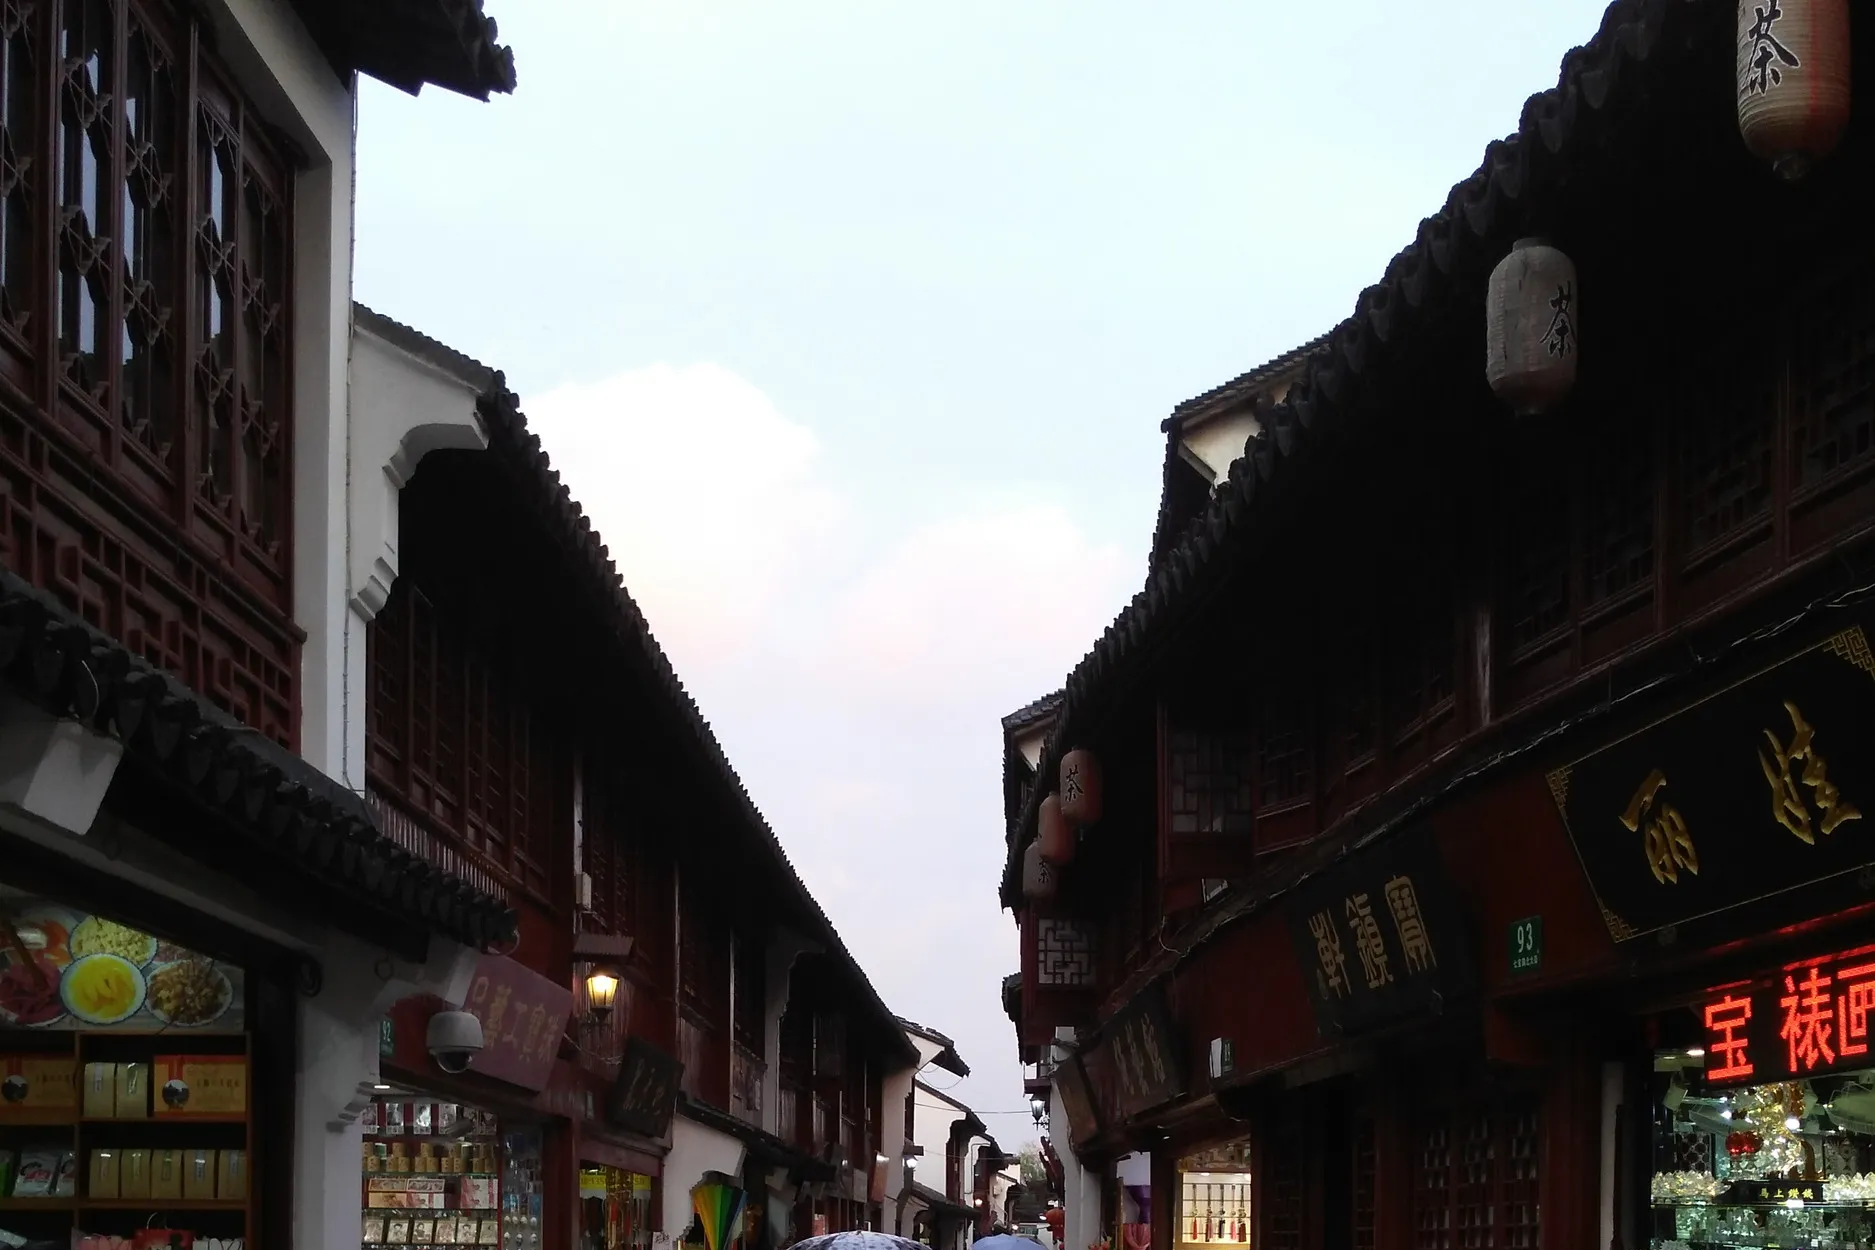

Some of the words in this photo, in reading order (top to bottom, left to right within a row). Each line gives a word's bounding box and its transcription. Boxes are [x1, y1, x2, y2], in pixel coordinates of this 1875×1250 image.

[1746, 0, 1801, 95] 茶
[1540, 280, 1576, 359] 茶
[1517, 922, 1534, 953] 93
